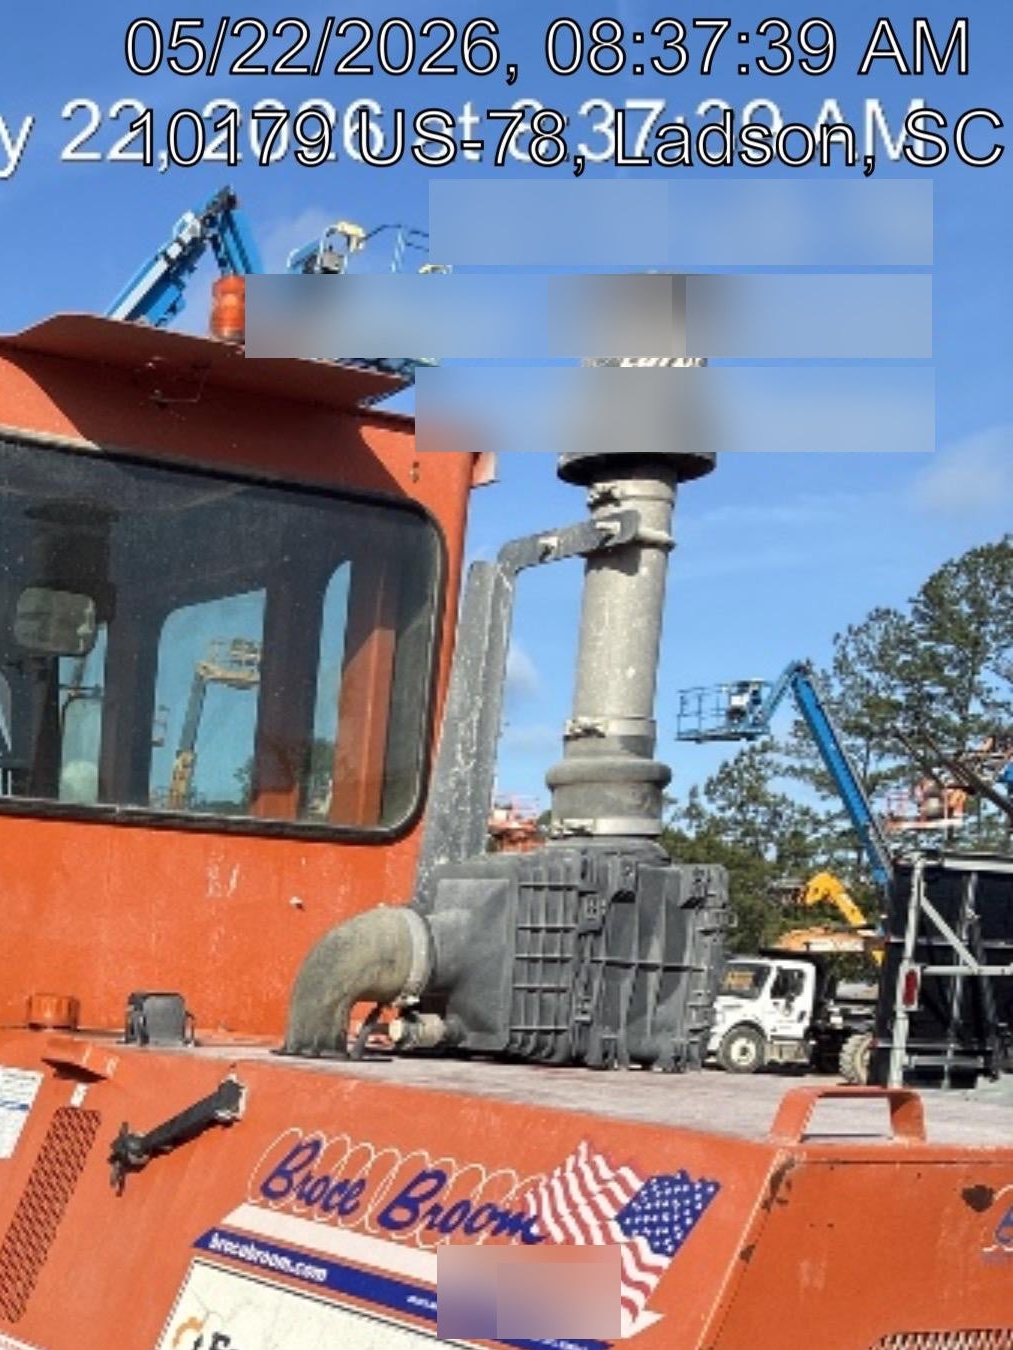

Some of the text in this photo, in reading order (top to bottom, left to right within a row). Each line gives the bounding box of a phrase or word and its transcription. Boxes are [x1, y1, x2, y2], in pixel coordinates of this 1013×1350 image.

[260, 1138, 547, 1245] Broce Broom
[208, 1230, 328, 1283] brocebroom.com
